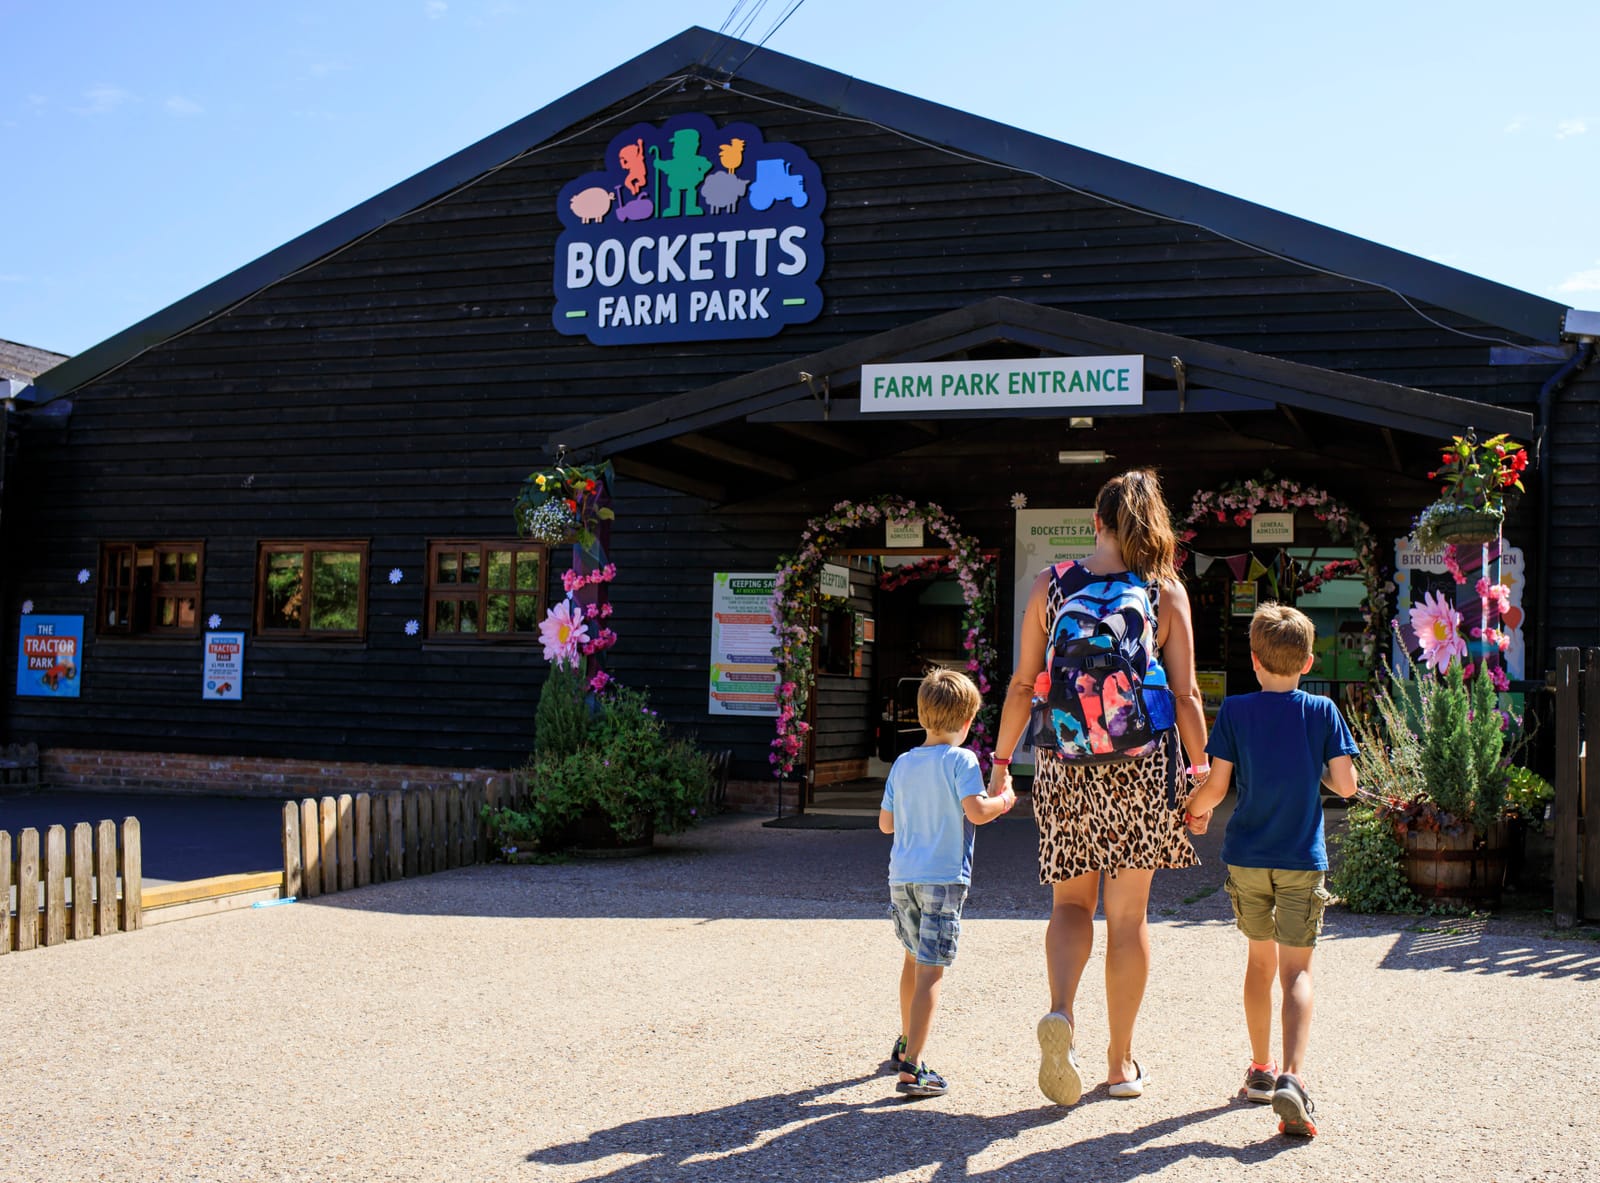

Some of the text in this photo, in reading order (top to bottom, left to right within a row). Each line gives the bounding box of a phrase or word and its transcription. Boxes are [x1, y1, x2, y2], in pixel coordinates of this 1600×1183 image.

[566, 225, 807, 289] BOCKETTS
[598, 287, 770, 327] FARM PARK
[873, 368, 1130, 399] FARM PARK ENTRANCE
[1031, 526, 1076, 536] BOCKETTS
[1402, 554, 1446, 565] BIRTHD
[732, 579, 762, 588] KEEPING
[822, 572, 847, 588] ECEPTION
[38, 624, 54, 635] THE
[26, 638, 74, 653] TRACTOR
[210, 644, 238, 653] TRACTOR
[30, 657, 54, 668] PARK
